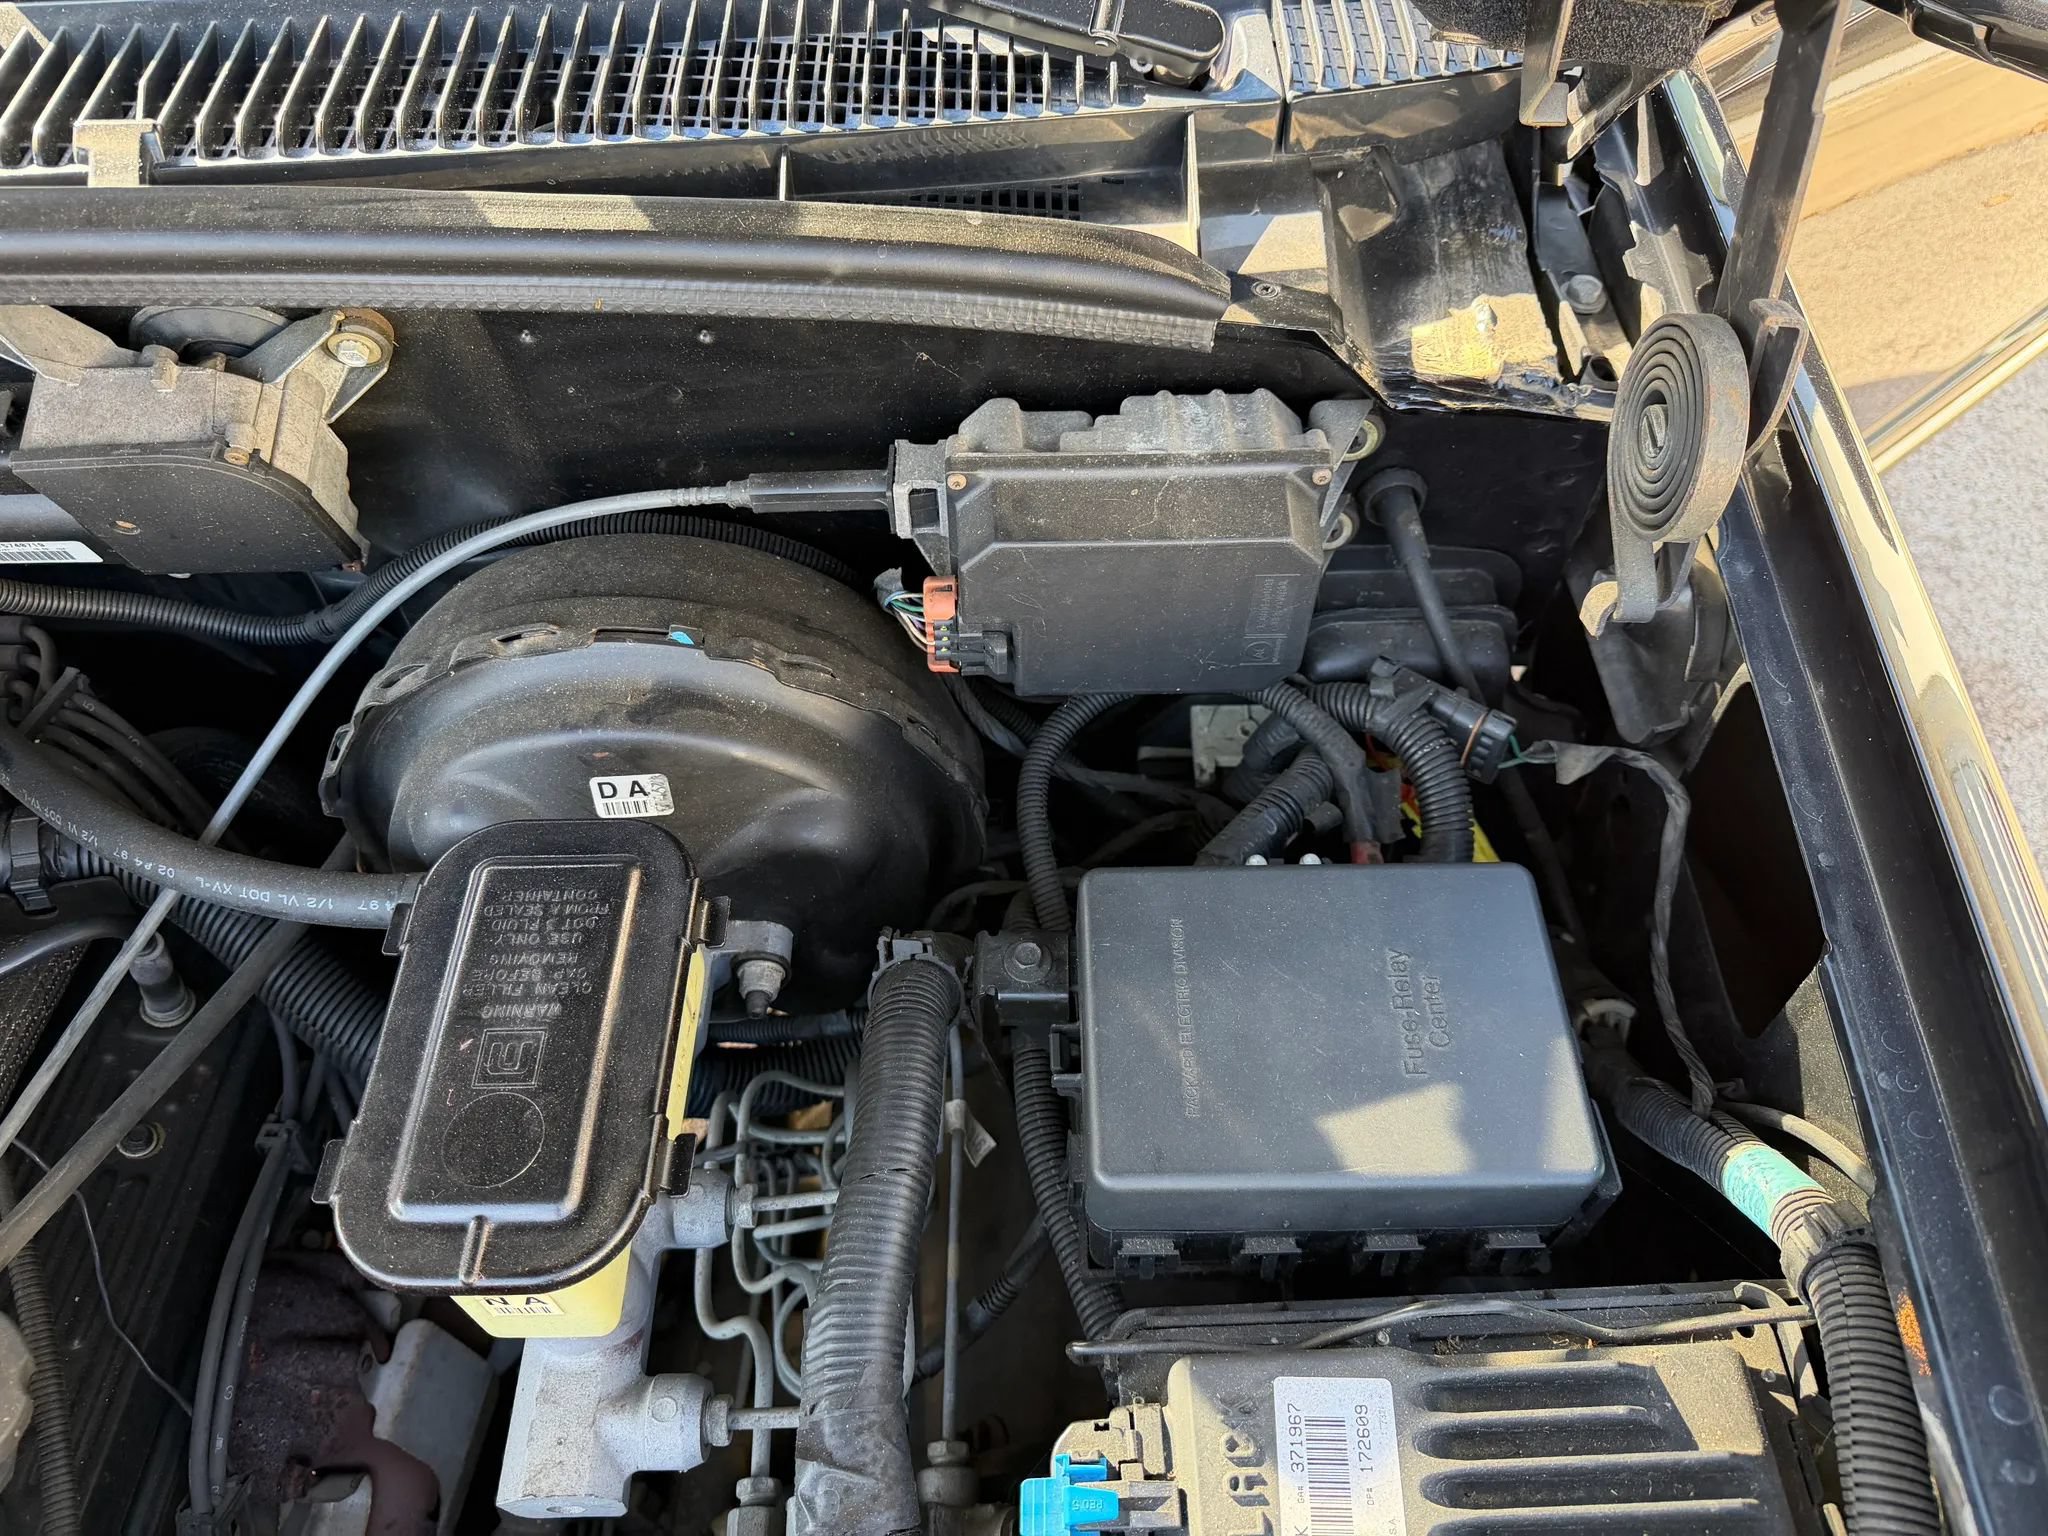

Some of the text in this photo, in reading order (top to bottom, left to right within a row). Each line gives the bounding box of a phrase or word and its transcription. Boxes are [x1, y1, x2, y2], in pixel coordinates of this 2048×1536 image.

[239, 886, 270, 903] DOT
[278, 893, 300, 908] VL
[502, 889, 599, 901] CONTAINER
[307, 897, 334, 911] 1/2
[357, 900, 379, 911] 97
[484, 903, 544, 917] SEALED
[566, 902, 610, 916] FROM
[491, 918, 540, 931] FLUID
[562, 916, 599, 930] DOT
[494, 931, 583, 946] USE ONLY
[489, 951, 579, 966] REMOVING
[471, 966, 588, 982] CAP BEFORE
[462, 981, 593, 997] CLEAN FILLER
[481, 1002, 563, 1019] WARNING
[1169, 917, 1201, 1118] PACKARD ELECTRIC DIVISION
[1386, 948, 1429, 1078] Fuse-Relay
[1418, 973, 1452, 1050] Center
[1287, 1402, 1306, 1473] 371967
[1354, 1404, 1374, 1473] 172609
